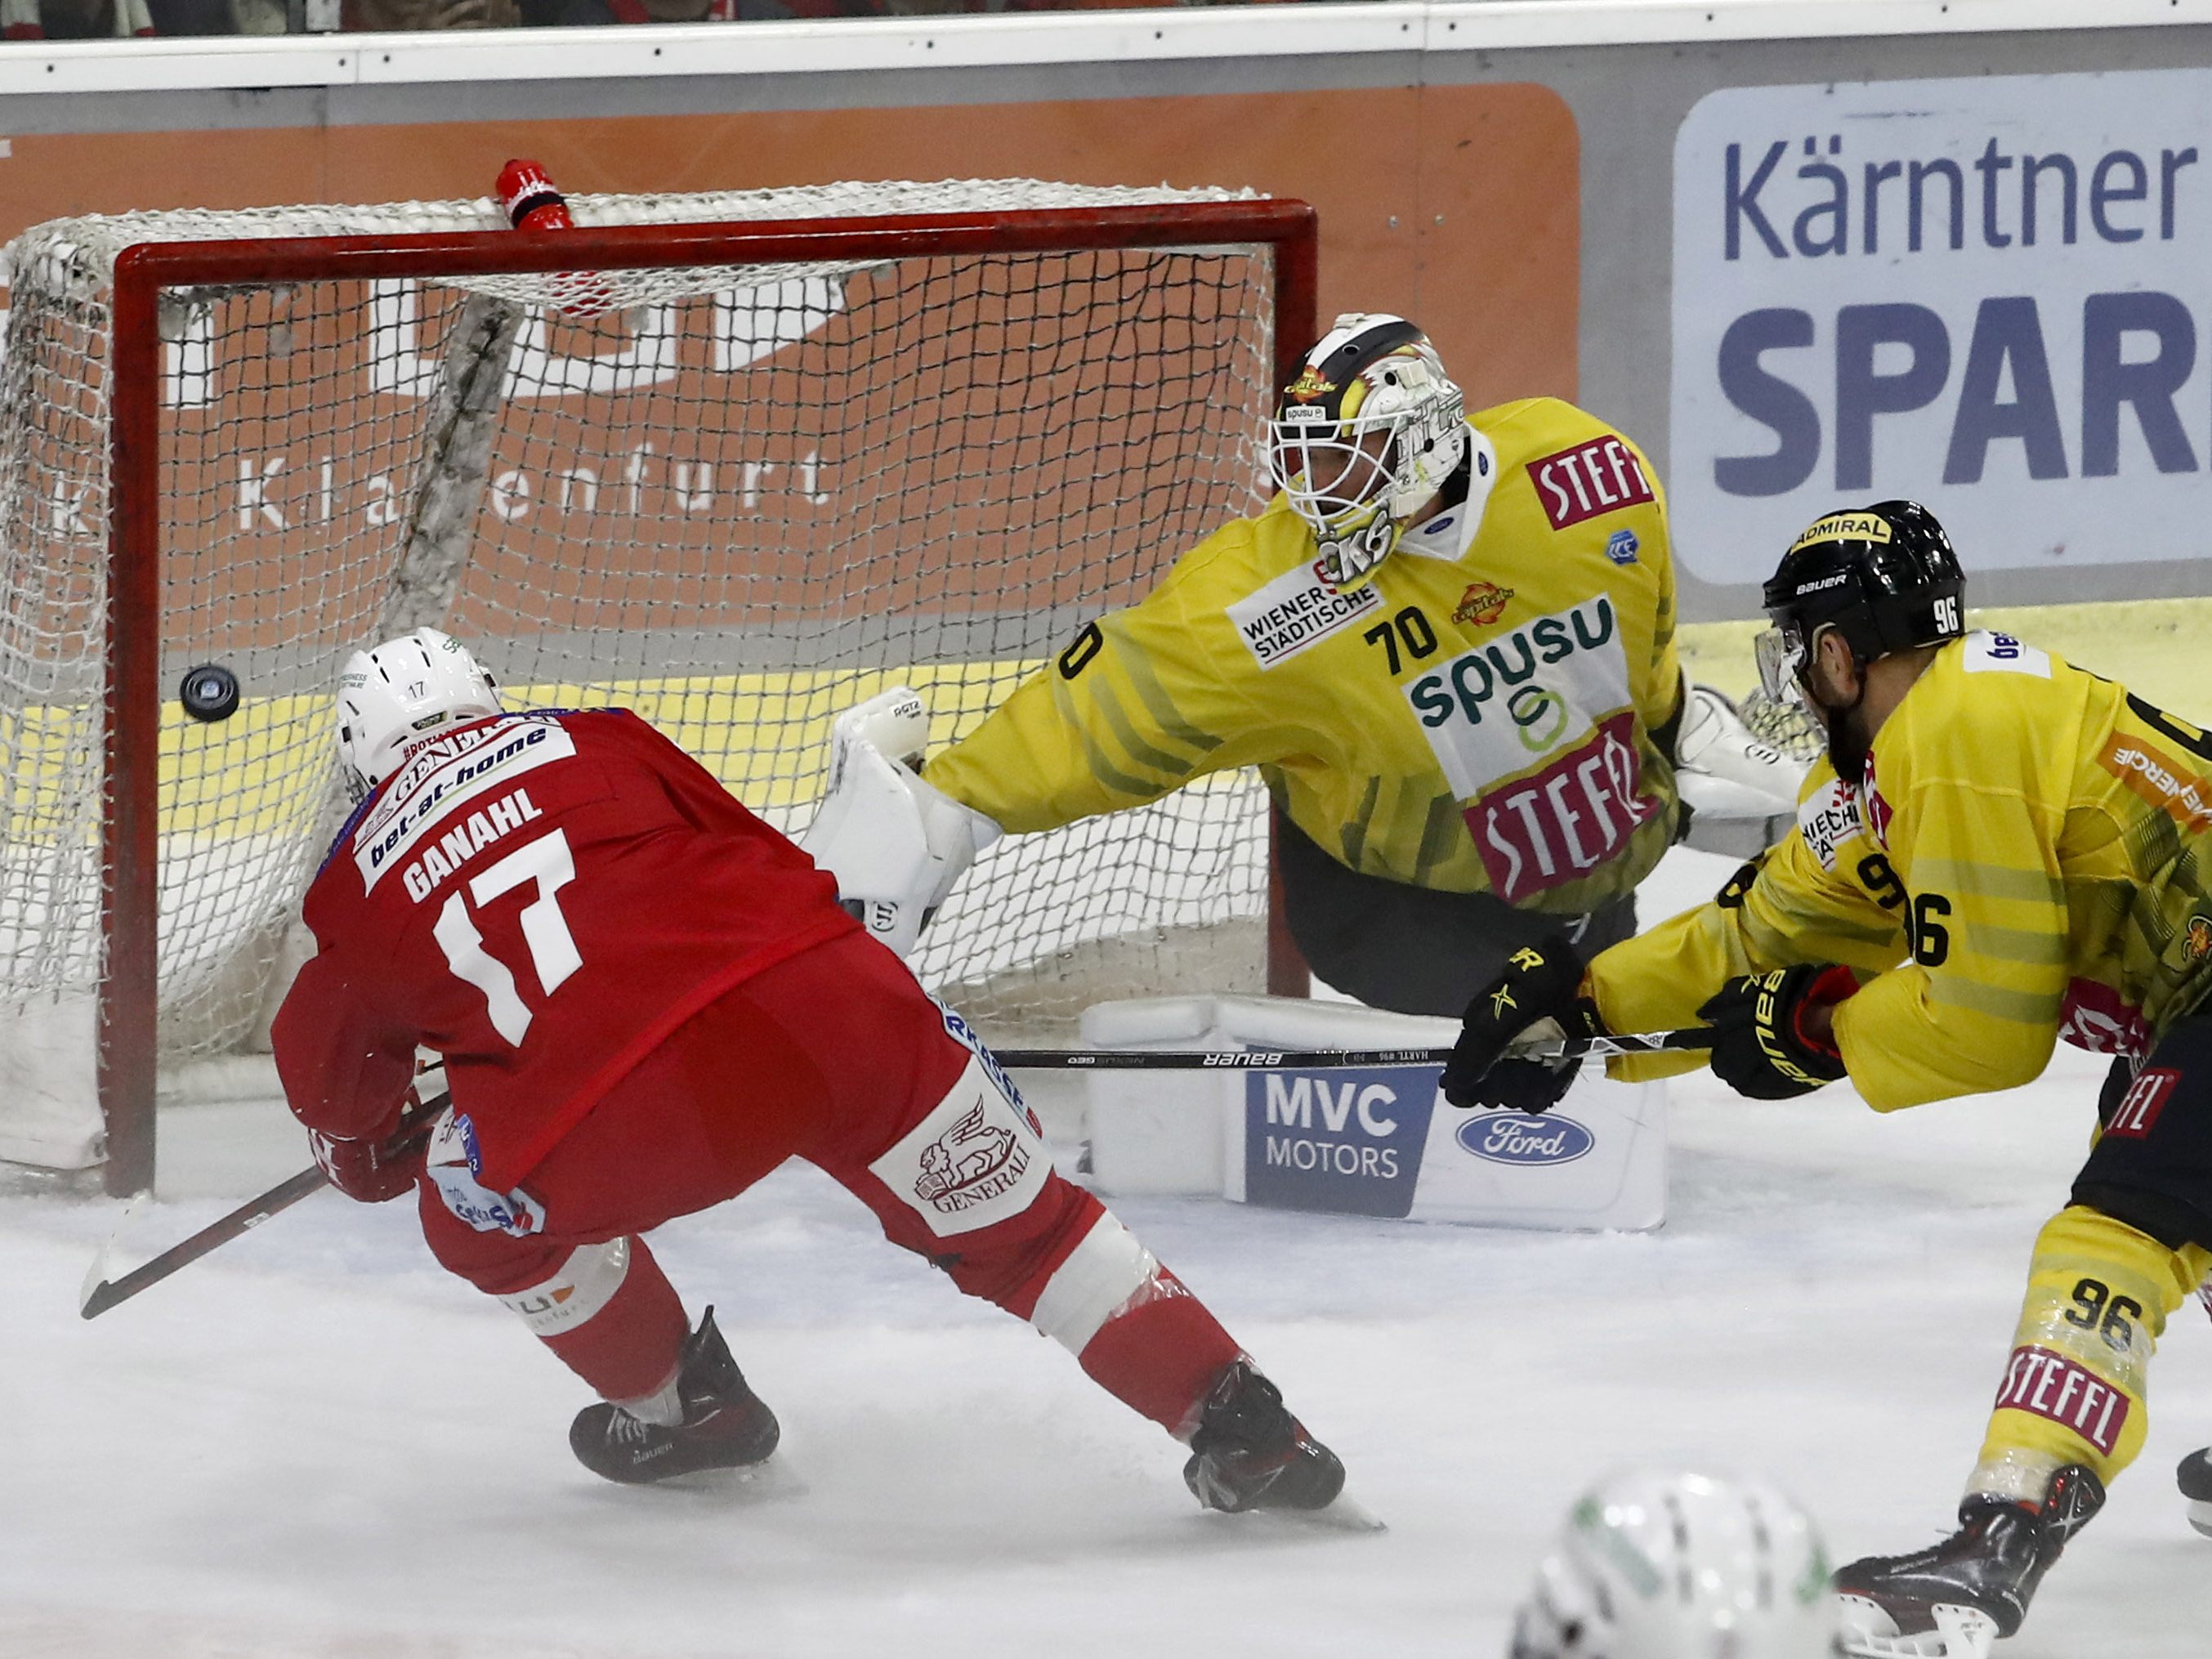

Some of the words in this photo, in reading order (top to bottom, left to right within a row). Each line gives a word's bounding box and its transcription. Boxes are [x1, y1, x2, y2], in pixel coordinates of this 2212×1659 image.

[1724, 135, 2198, 261] Kärntner
[1288, 410, 1313, 419] spusu
[239, 444, 830, 532] Klaenfurt
[1798, 520, 1888, 544] ADMIRAL
[1244, 588, 1326, 640] WIENER
[1797, 575, 1848, 595] BAUER
[1933, 597, 1959, 634] 96
[1254, 584, 1374, 659] STÄDTISCHE
[1364, 606, 1437, 675] 70
[409, 681, 425, 698] 17
[1411, 598, 1612, 728] spusu
[371, 727, 546, 868] bet-at-home
[402, 788, 543, 903] GANAHL
[432, 828, 577, 1048] 17
[1203, 1053, 1282, 1066] BAUER
[1266, 1074, 1397, 1137] MVC
[1483, 1118, 1565, 1156] Ford
[933, 1144, 1030, 1214] GENERALI
[1266, 1136, 1399, 1179] MOTORS
[2065, 1278, 2142, 1352] 96
[1997, 1352, 2118, 1448] STEFFL
